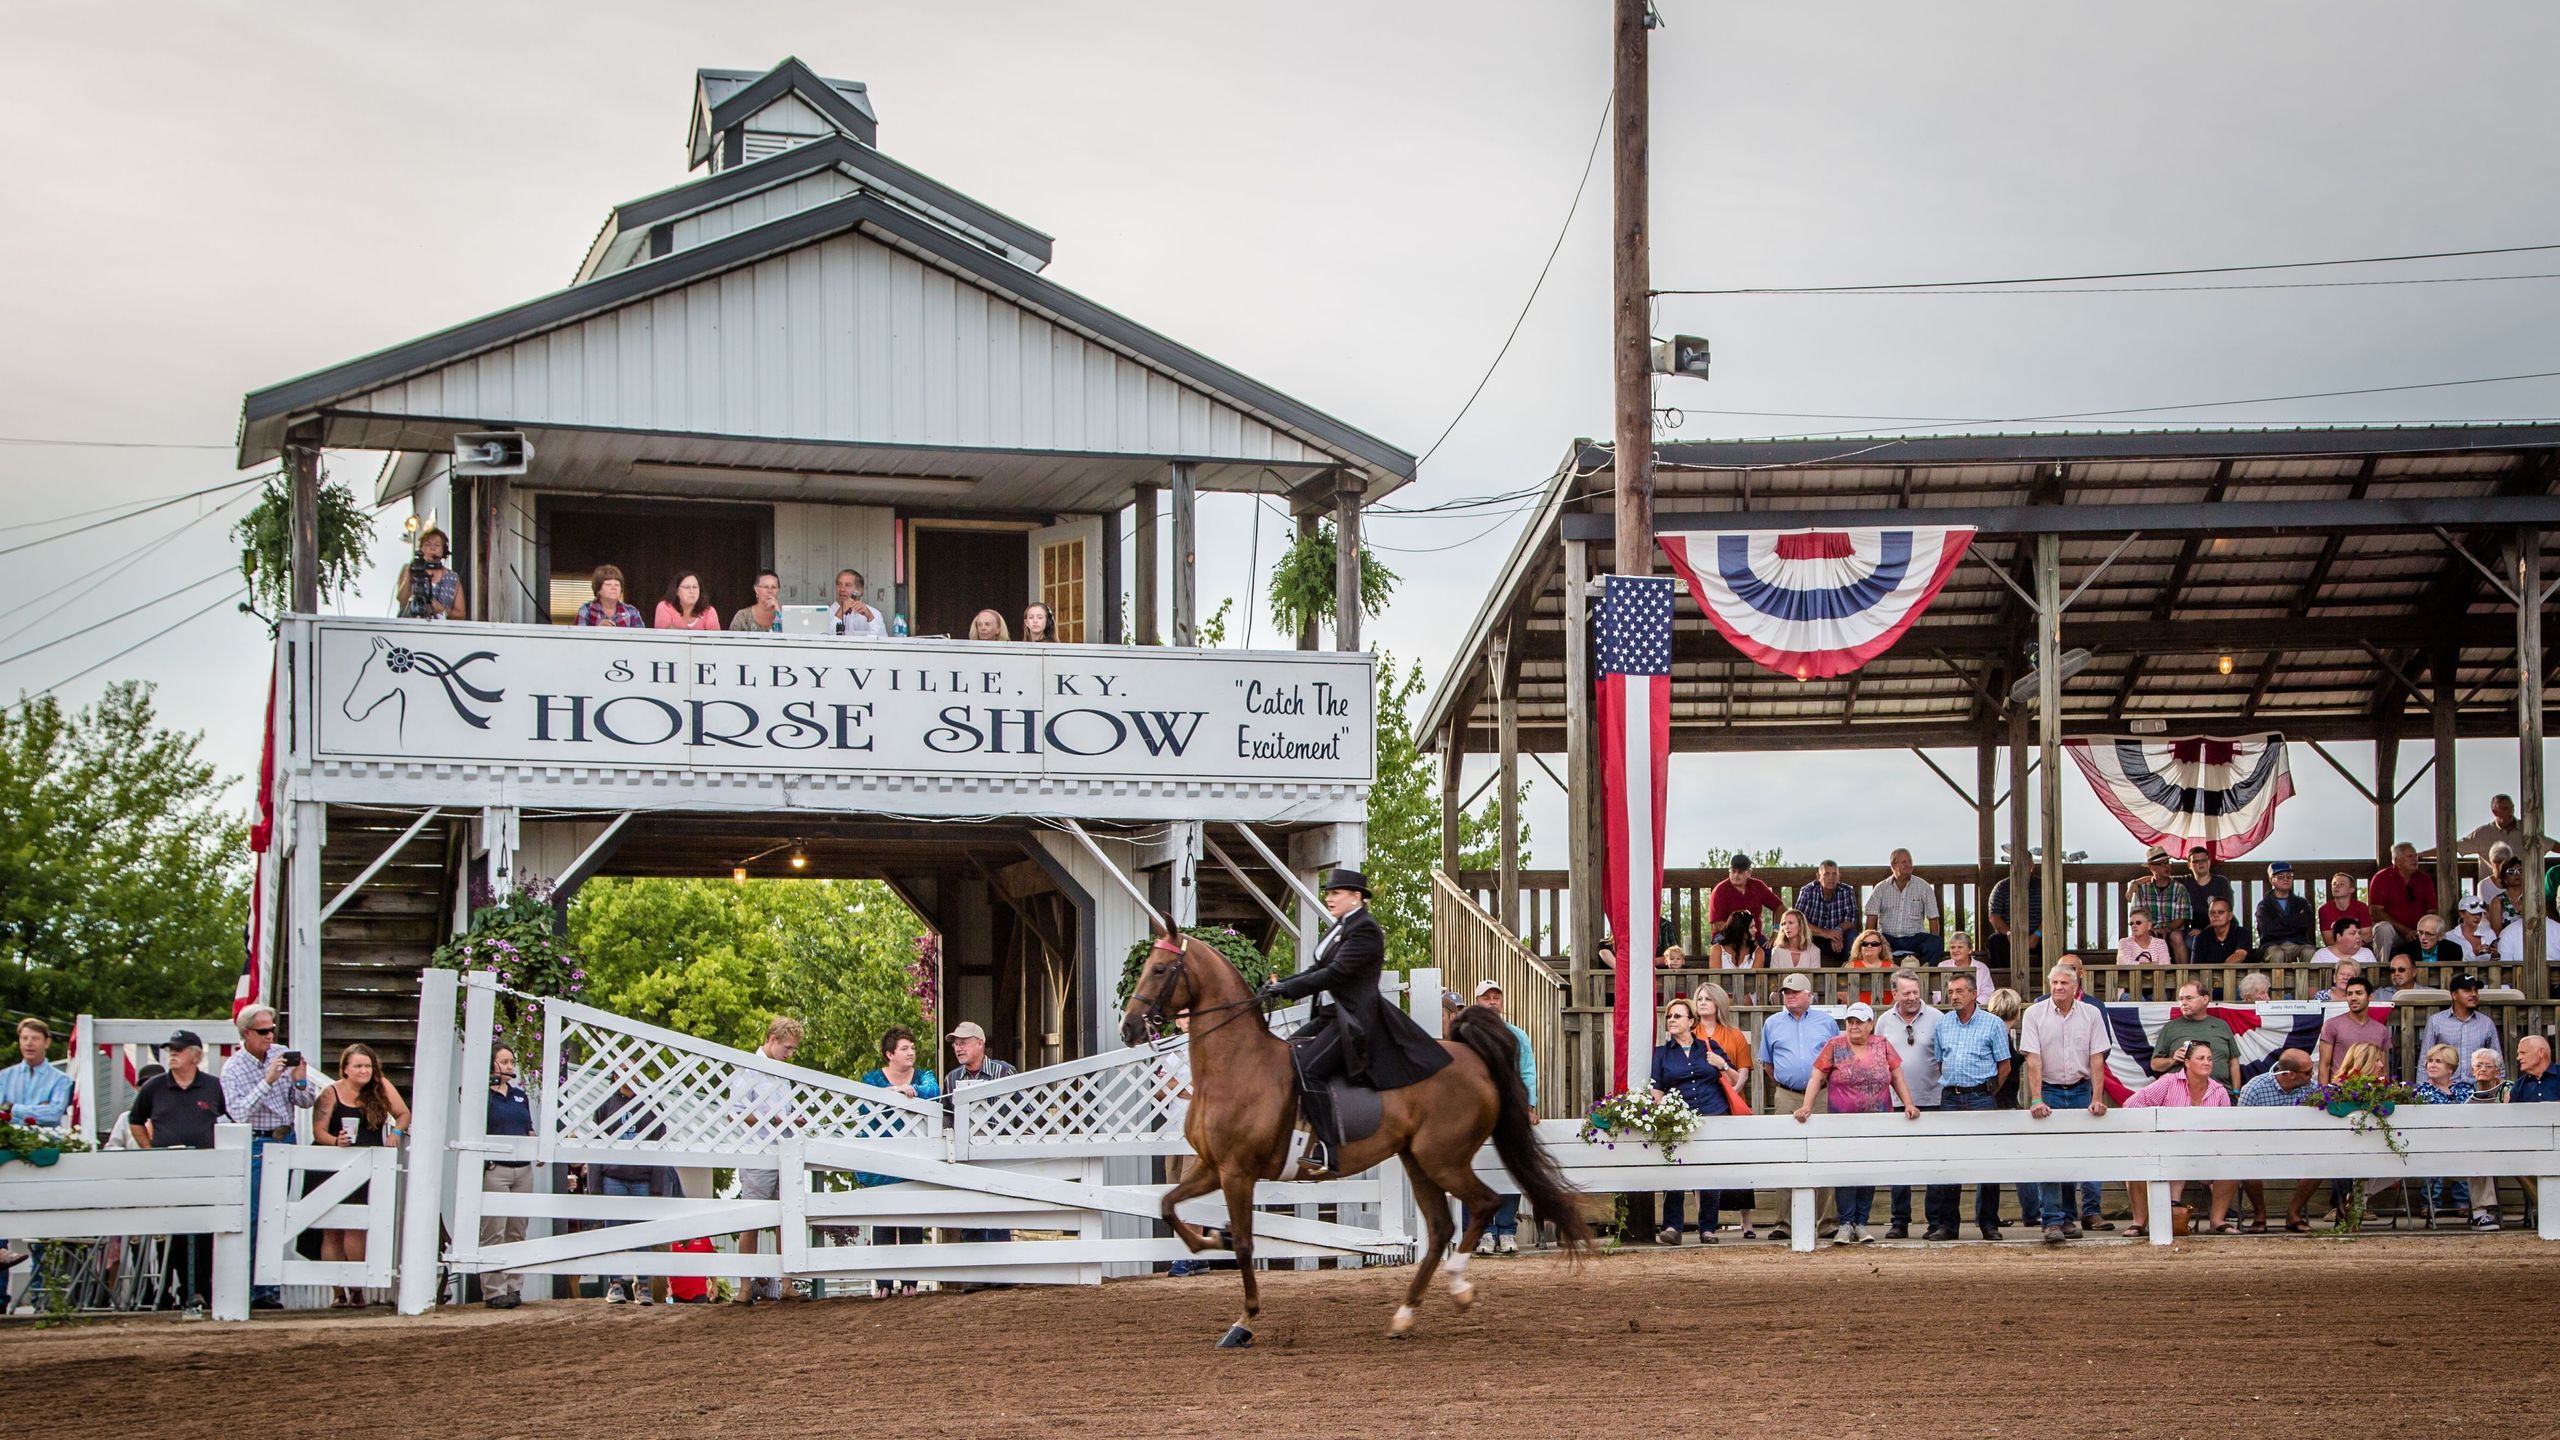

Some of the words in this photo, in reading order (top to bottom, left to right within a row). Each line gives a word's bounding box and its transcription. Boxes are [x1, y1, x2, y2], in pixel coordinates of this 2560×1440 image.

[604, 658, 1024, 698] SHELBYVILLE,
[1054, 674, 1128, 698] KY.
[1235, 679, 1304, 717] "Catch
[1311, 682, 1349, 717] The
[528, 694, 874, 753] HORSE
[923, 705, 1210, 757] SHOW
[1237, 723, 1350, 761] Excitement"
